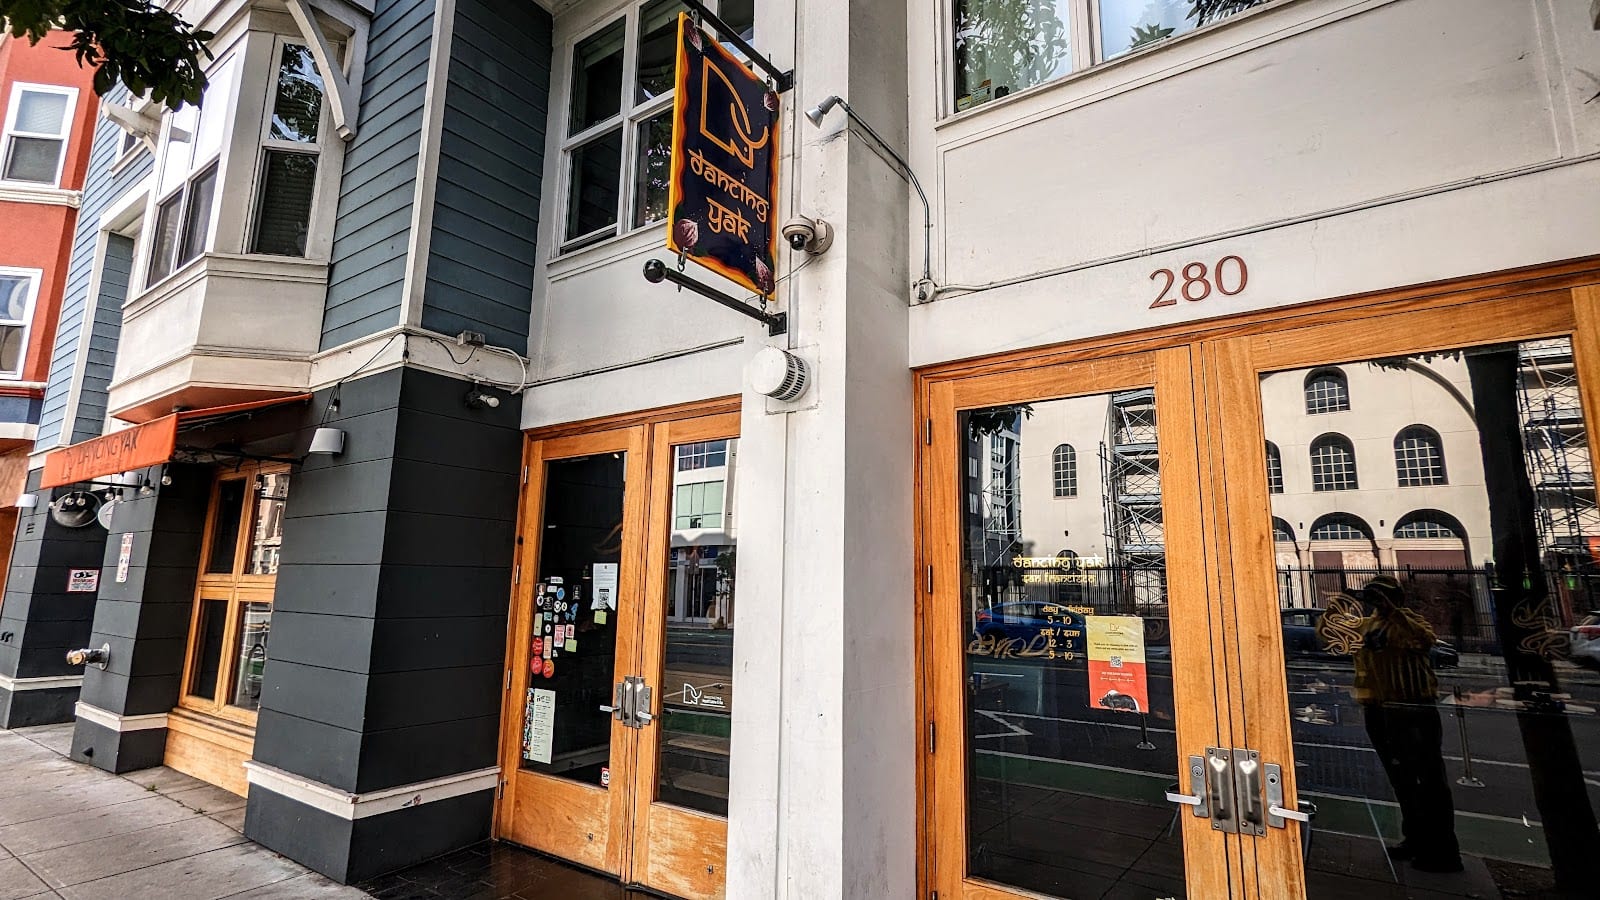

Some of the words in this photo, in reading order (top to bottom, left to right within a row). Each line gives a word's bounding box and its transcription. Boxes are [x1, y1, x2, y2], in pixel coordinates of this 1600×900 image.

[687, 148, 769, 223] dancing
[705, 196, 752, 244] yak
[1148, 255, 1248, 309] 280
[1012, 554, 1071, 571] dancing
[1075, 553, 1105, 570] yak
[1047, 616, 1053, 625] 5
[1062, 616, 1072, 625] 10
[1048, 639, 1057, 648] 12
[1066, 640, 1073, 649] 3
[1048, 651, 1055, 660] 5
